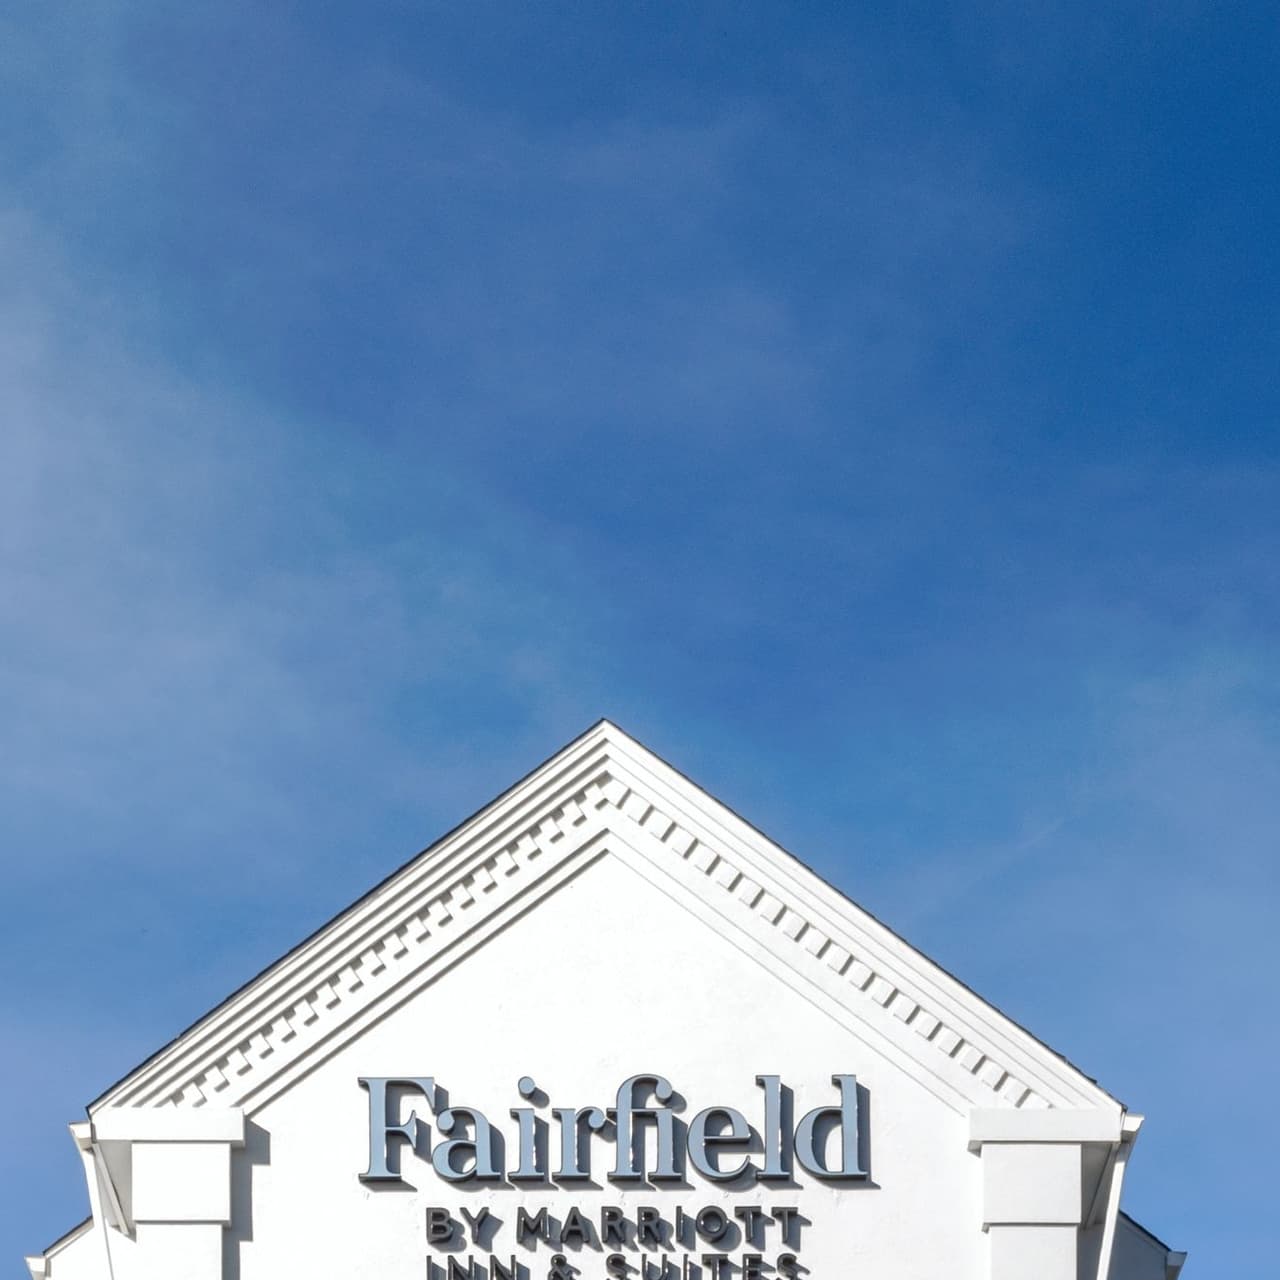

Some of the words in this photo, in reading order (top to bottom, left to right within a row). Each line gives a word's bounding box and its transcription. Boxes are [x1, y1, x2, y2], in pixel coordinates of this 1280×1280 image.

[357, 1072, 869, 1183] Fairfield
[426, 1205, 489, 1244] BY
[516, 1205, 799, 1244] MARRIOTT
